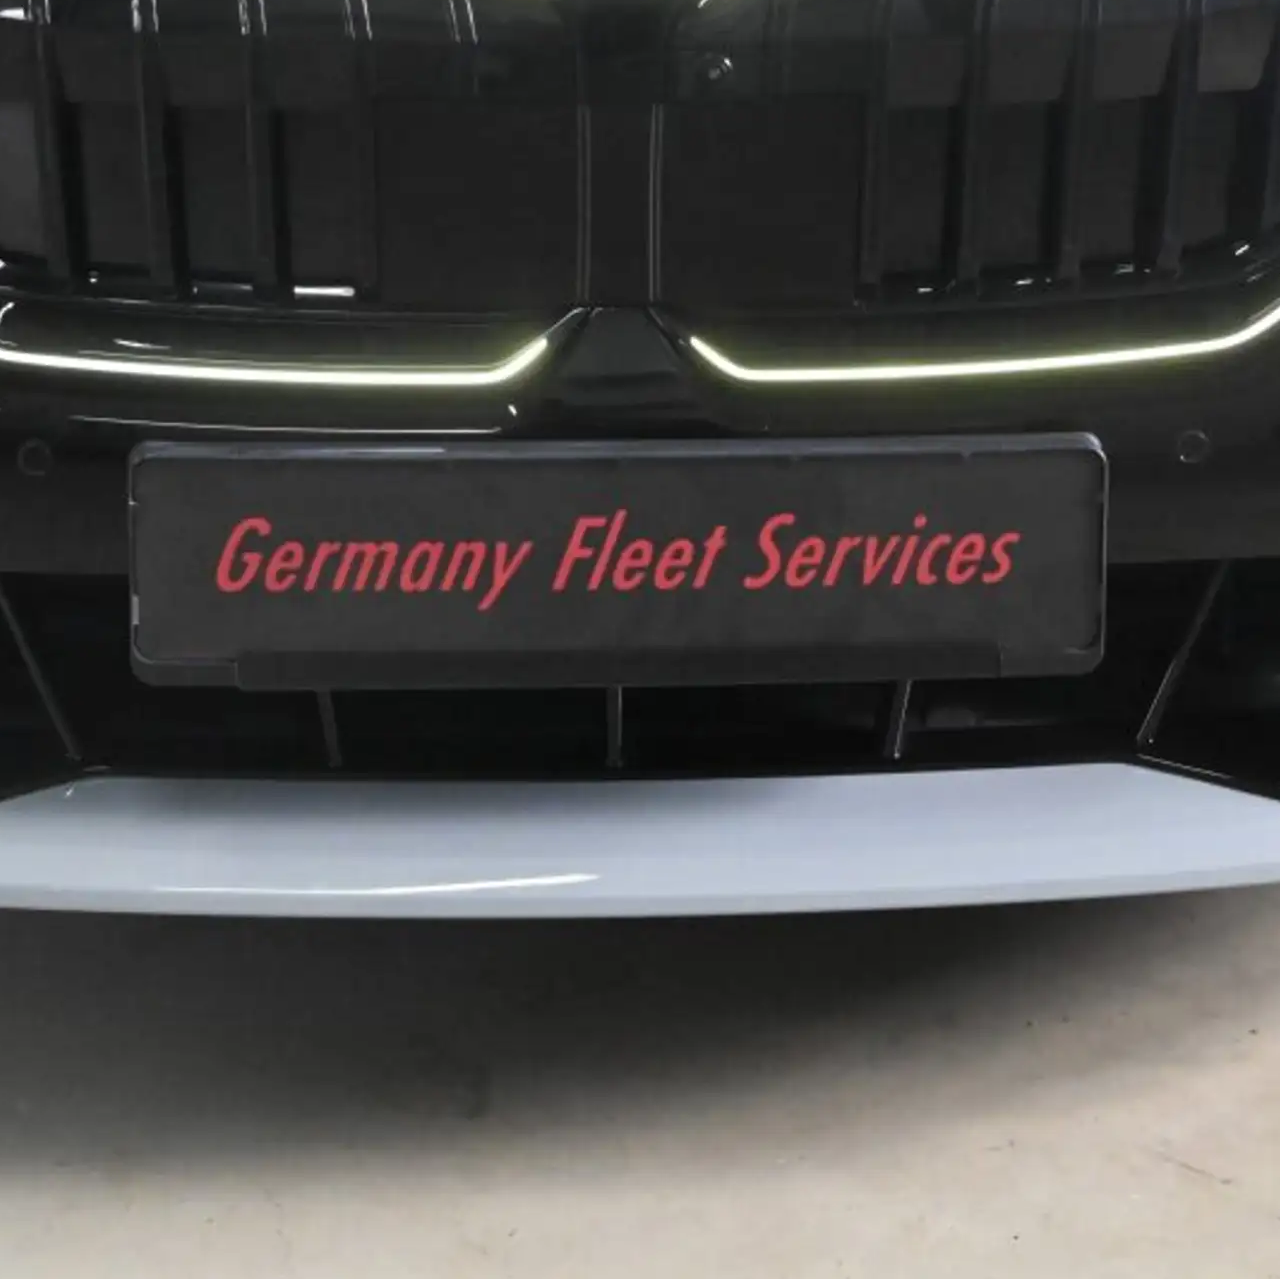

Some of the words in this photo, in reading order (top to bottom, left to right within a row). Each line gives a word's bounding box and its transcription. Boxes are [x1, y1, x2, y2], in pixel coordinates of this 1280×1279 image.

[216, 515, 532, 609] Germany
[552, 508, 727, 593] Fleet
[742, 512, 1021, 590] Services
